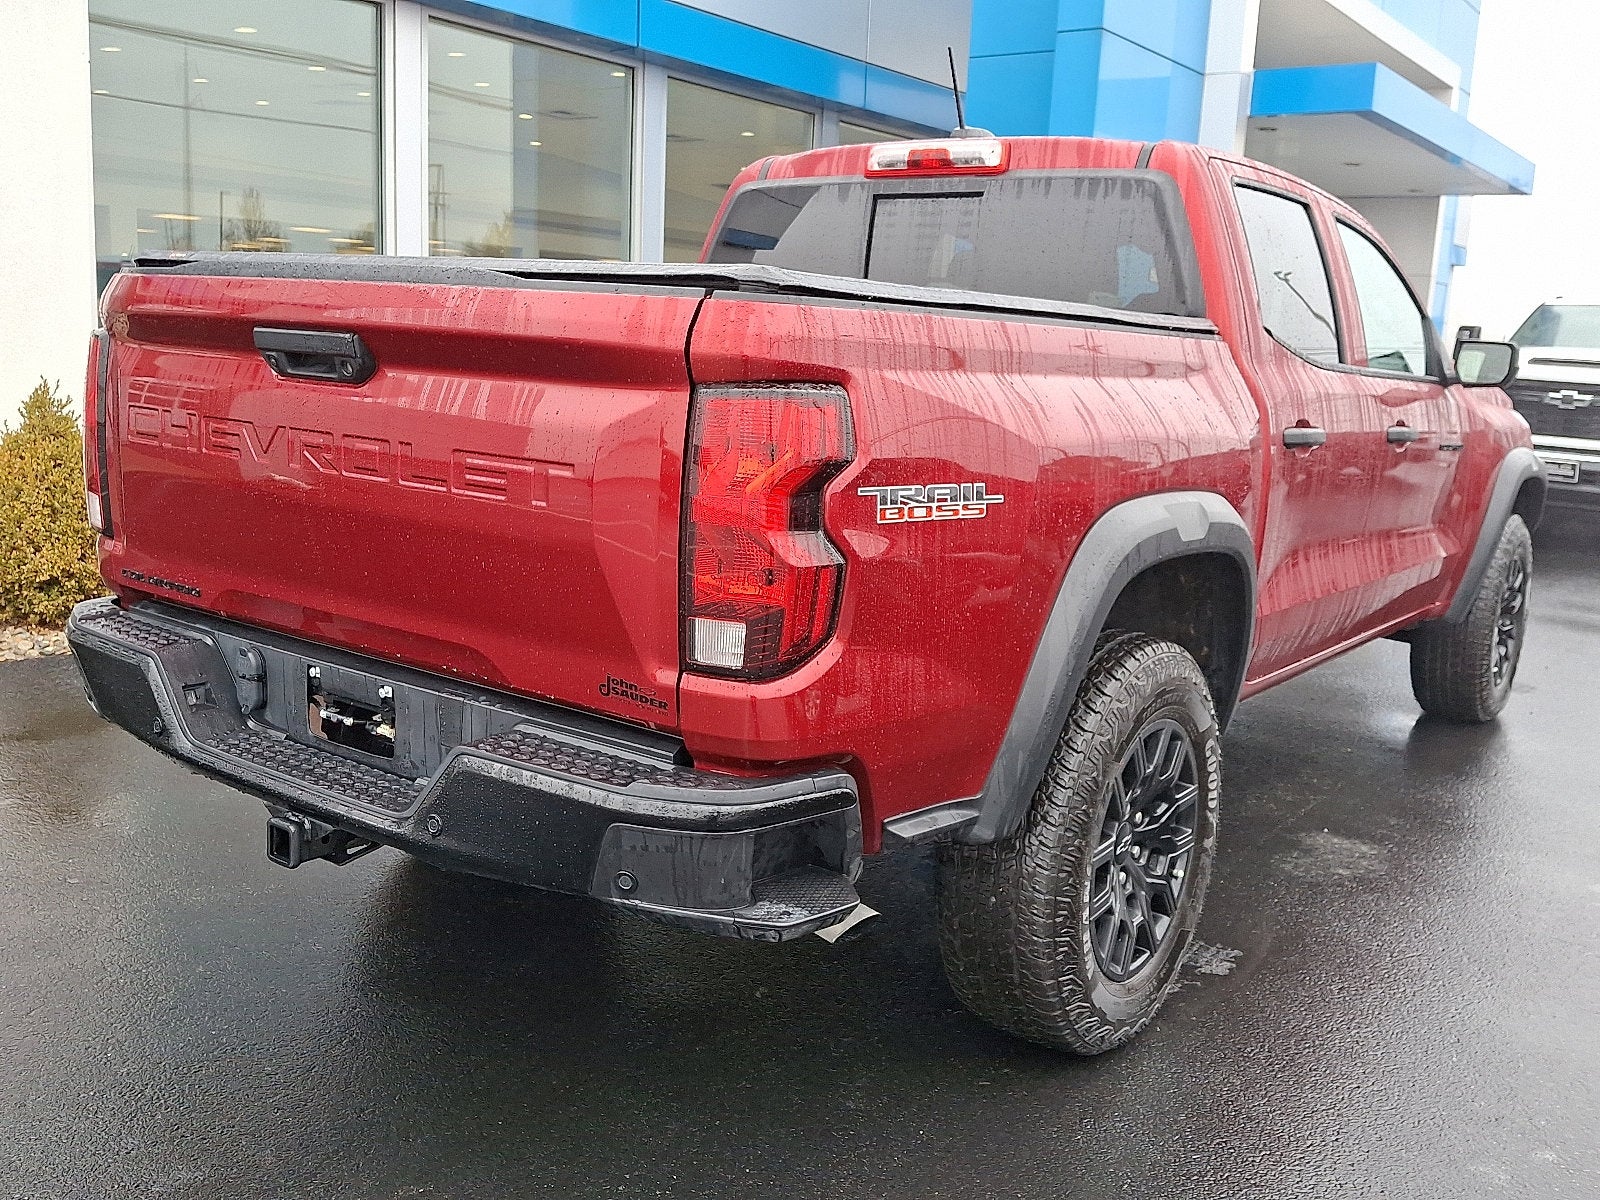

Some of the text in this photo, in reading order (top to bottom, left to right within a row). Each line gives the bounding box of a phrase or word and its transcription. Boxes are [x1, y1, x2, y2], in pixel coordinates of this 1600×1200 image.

[127, 403, 576, 507] CHEVROLET
[858, 483, 1004, 506] TRAIL
[878, 503, 986, 523] BOSS
[599, 672, 638, 697] John
[611, 686, 669, 711] SAUDER
